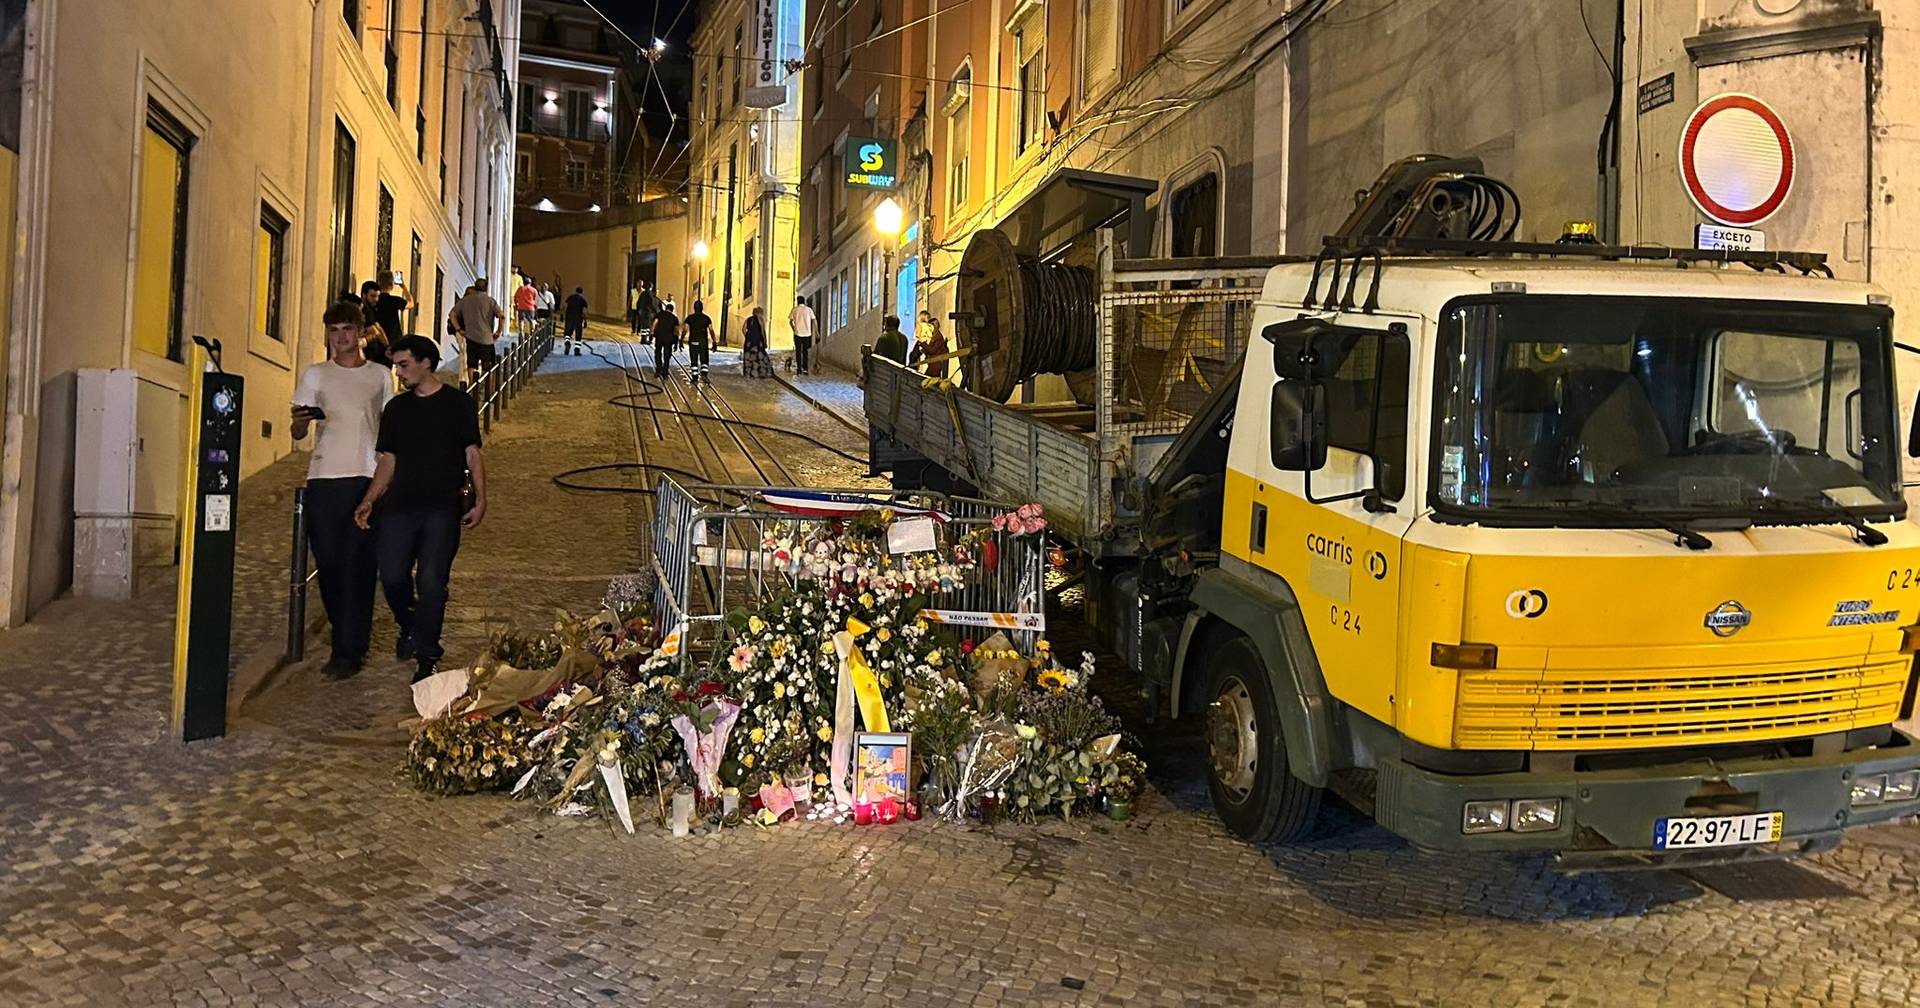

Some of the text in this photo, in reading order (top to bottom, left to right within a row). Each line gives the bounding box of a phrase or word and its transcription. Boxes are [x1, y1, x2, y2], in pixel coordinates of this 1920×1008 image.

[847, 173, 894, 187] SUBWAY
[1713, 230, 1752, 244] EXCETO
[1306, 533, 1353, 565] carris
[1712, 614, 1748, 625] NISSAN
